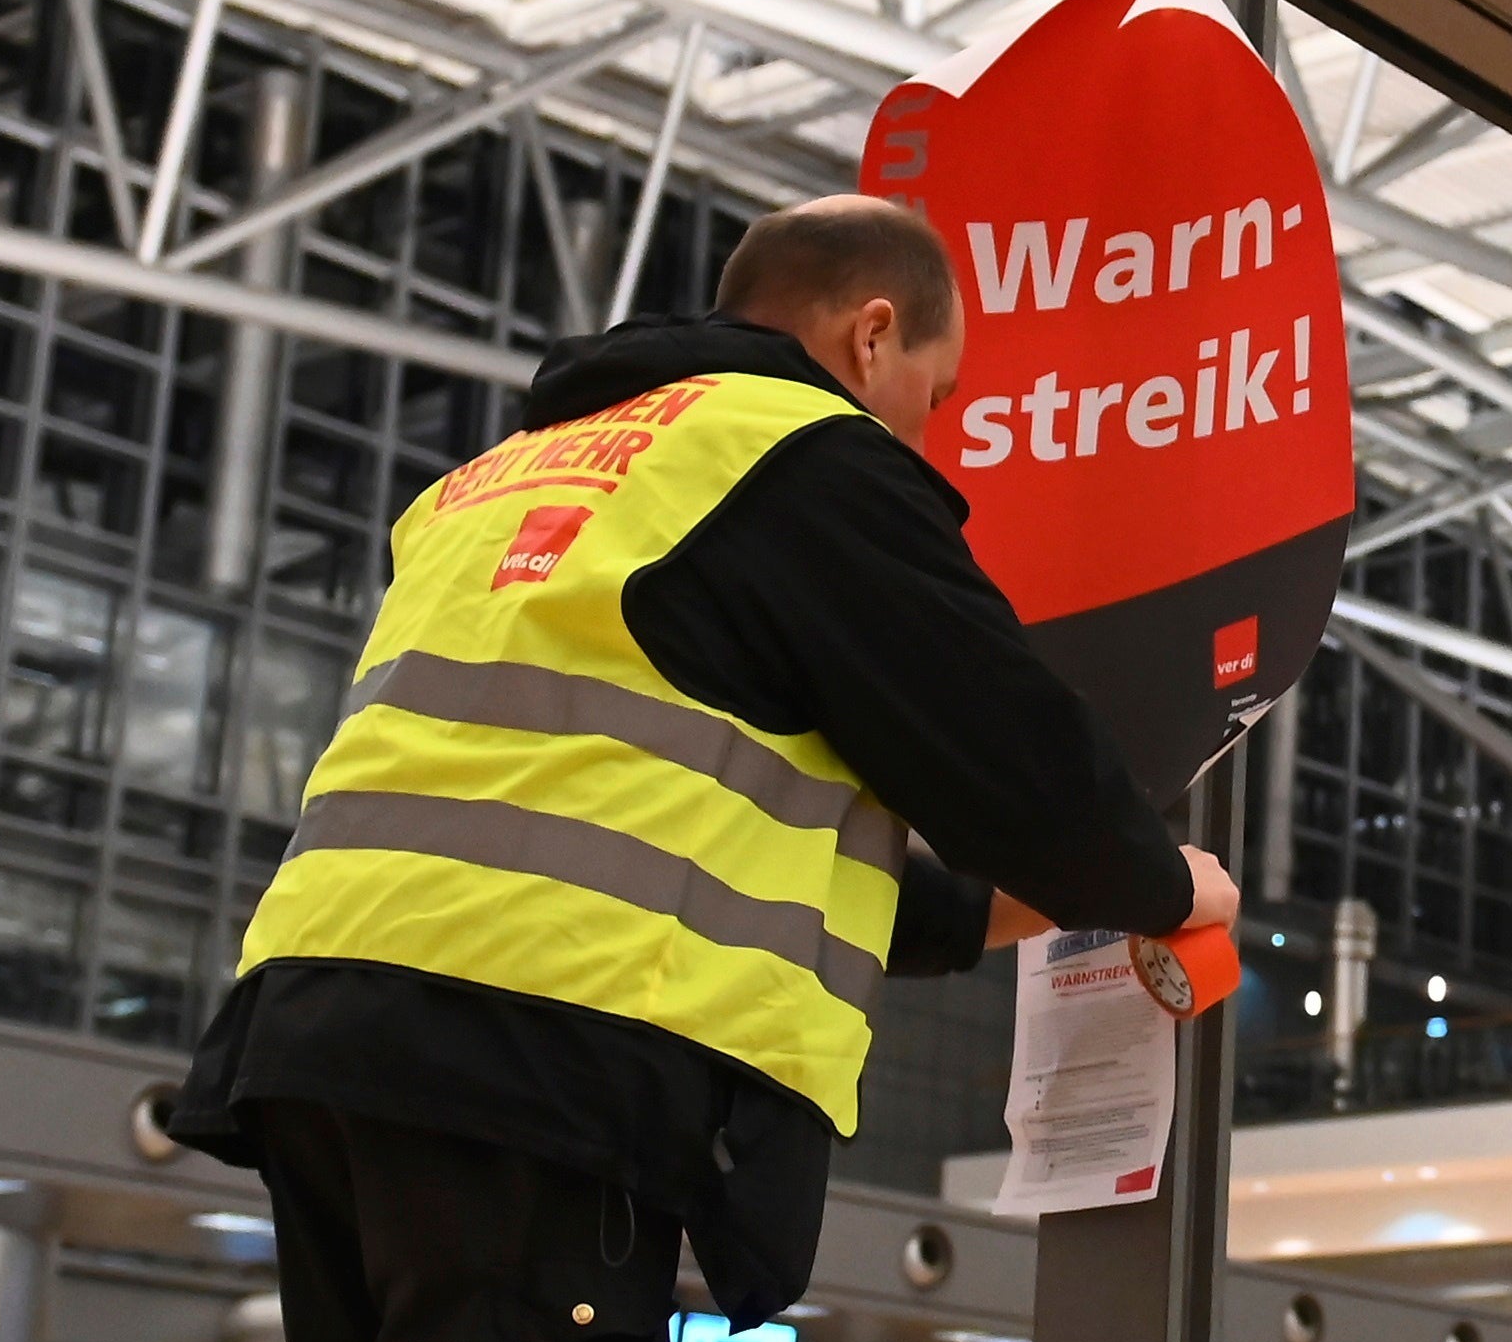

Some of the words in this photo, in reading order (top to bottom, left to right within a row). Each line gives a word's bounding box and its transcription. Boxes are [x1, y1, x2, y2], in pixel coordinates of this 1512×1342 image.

[966, 197, 1302, 315] Warn-
[959, 315, 1310, 468] streik!
[501, 552, 559, 575] ver.di
